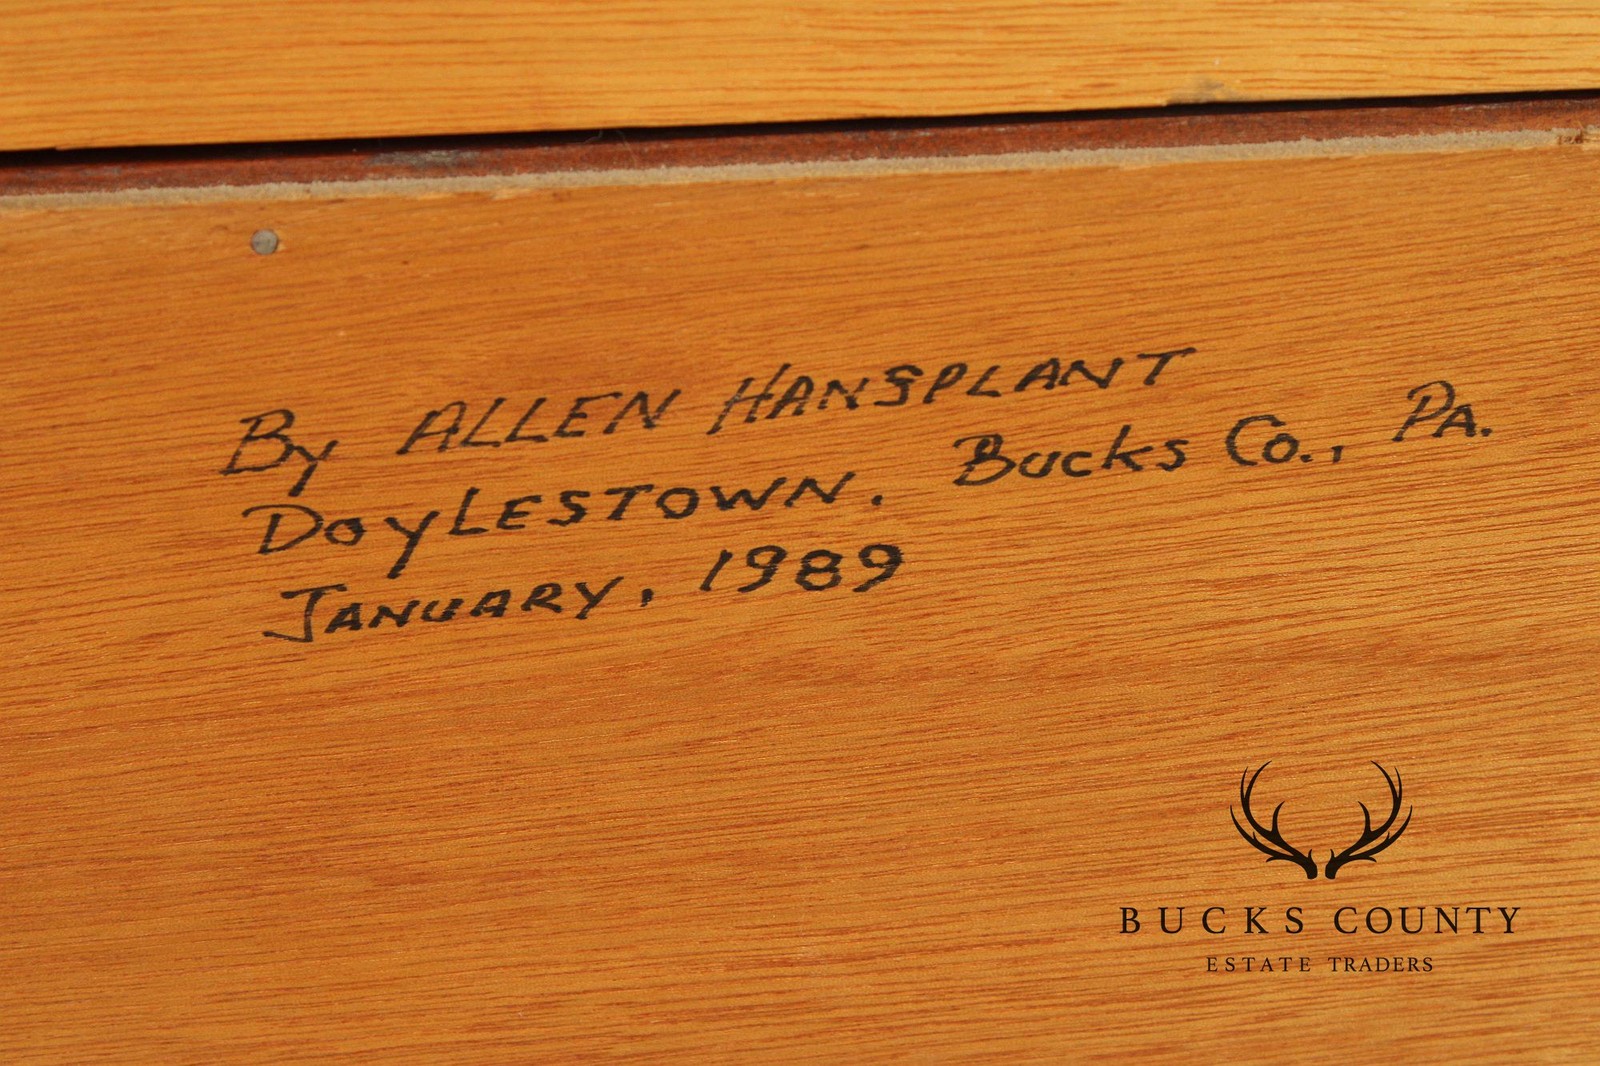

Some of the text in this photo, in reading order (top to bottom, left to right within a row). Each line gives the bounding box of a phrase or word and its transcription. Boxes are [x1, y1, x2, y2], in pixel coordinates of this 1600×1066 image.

[395, 388, 682, 456] ALLEN
[706, 346, 1197, 437] HANSPLANT
[699, 542, 906, 594] 1989
